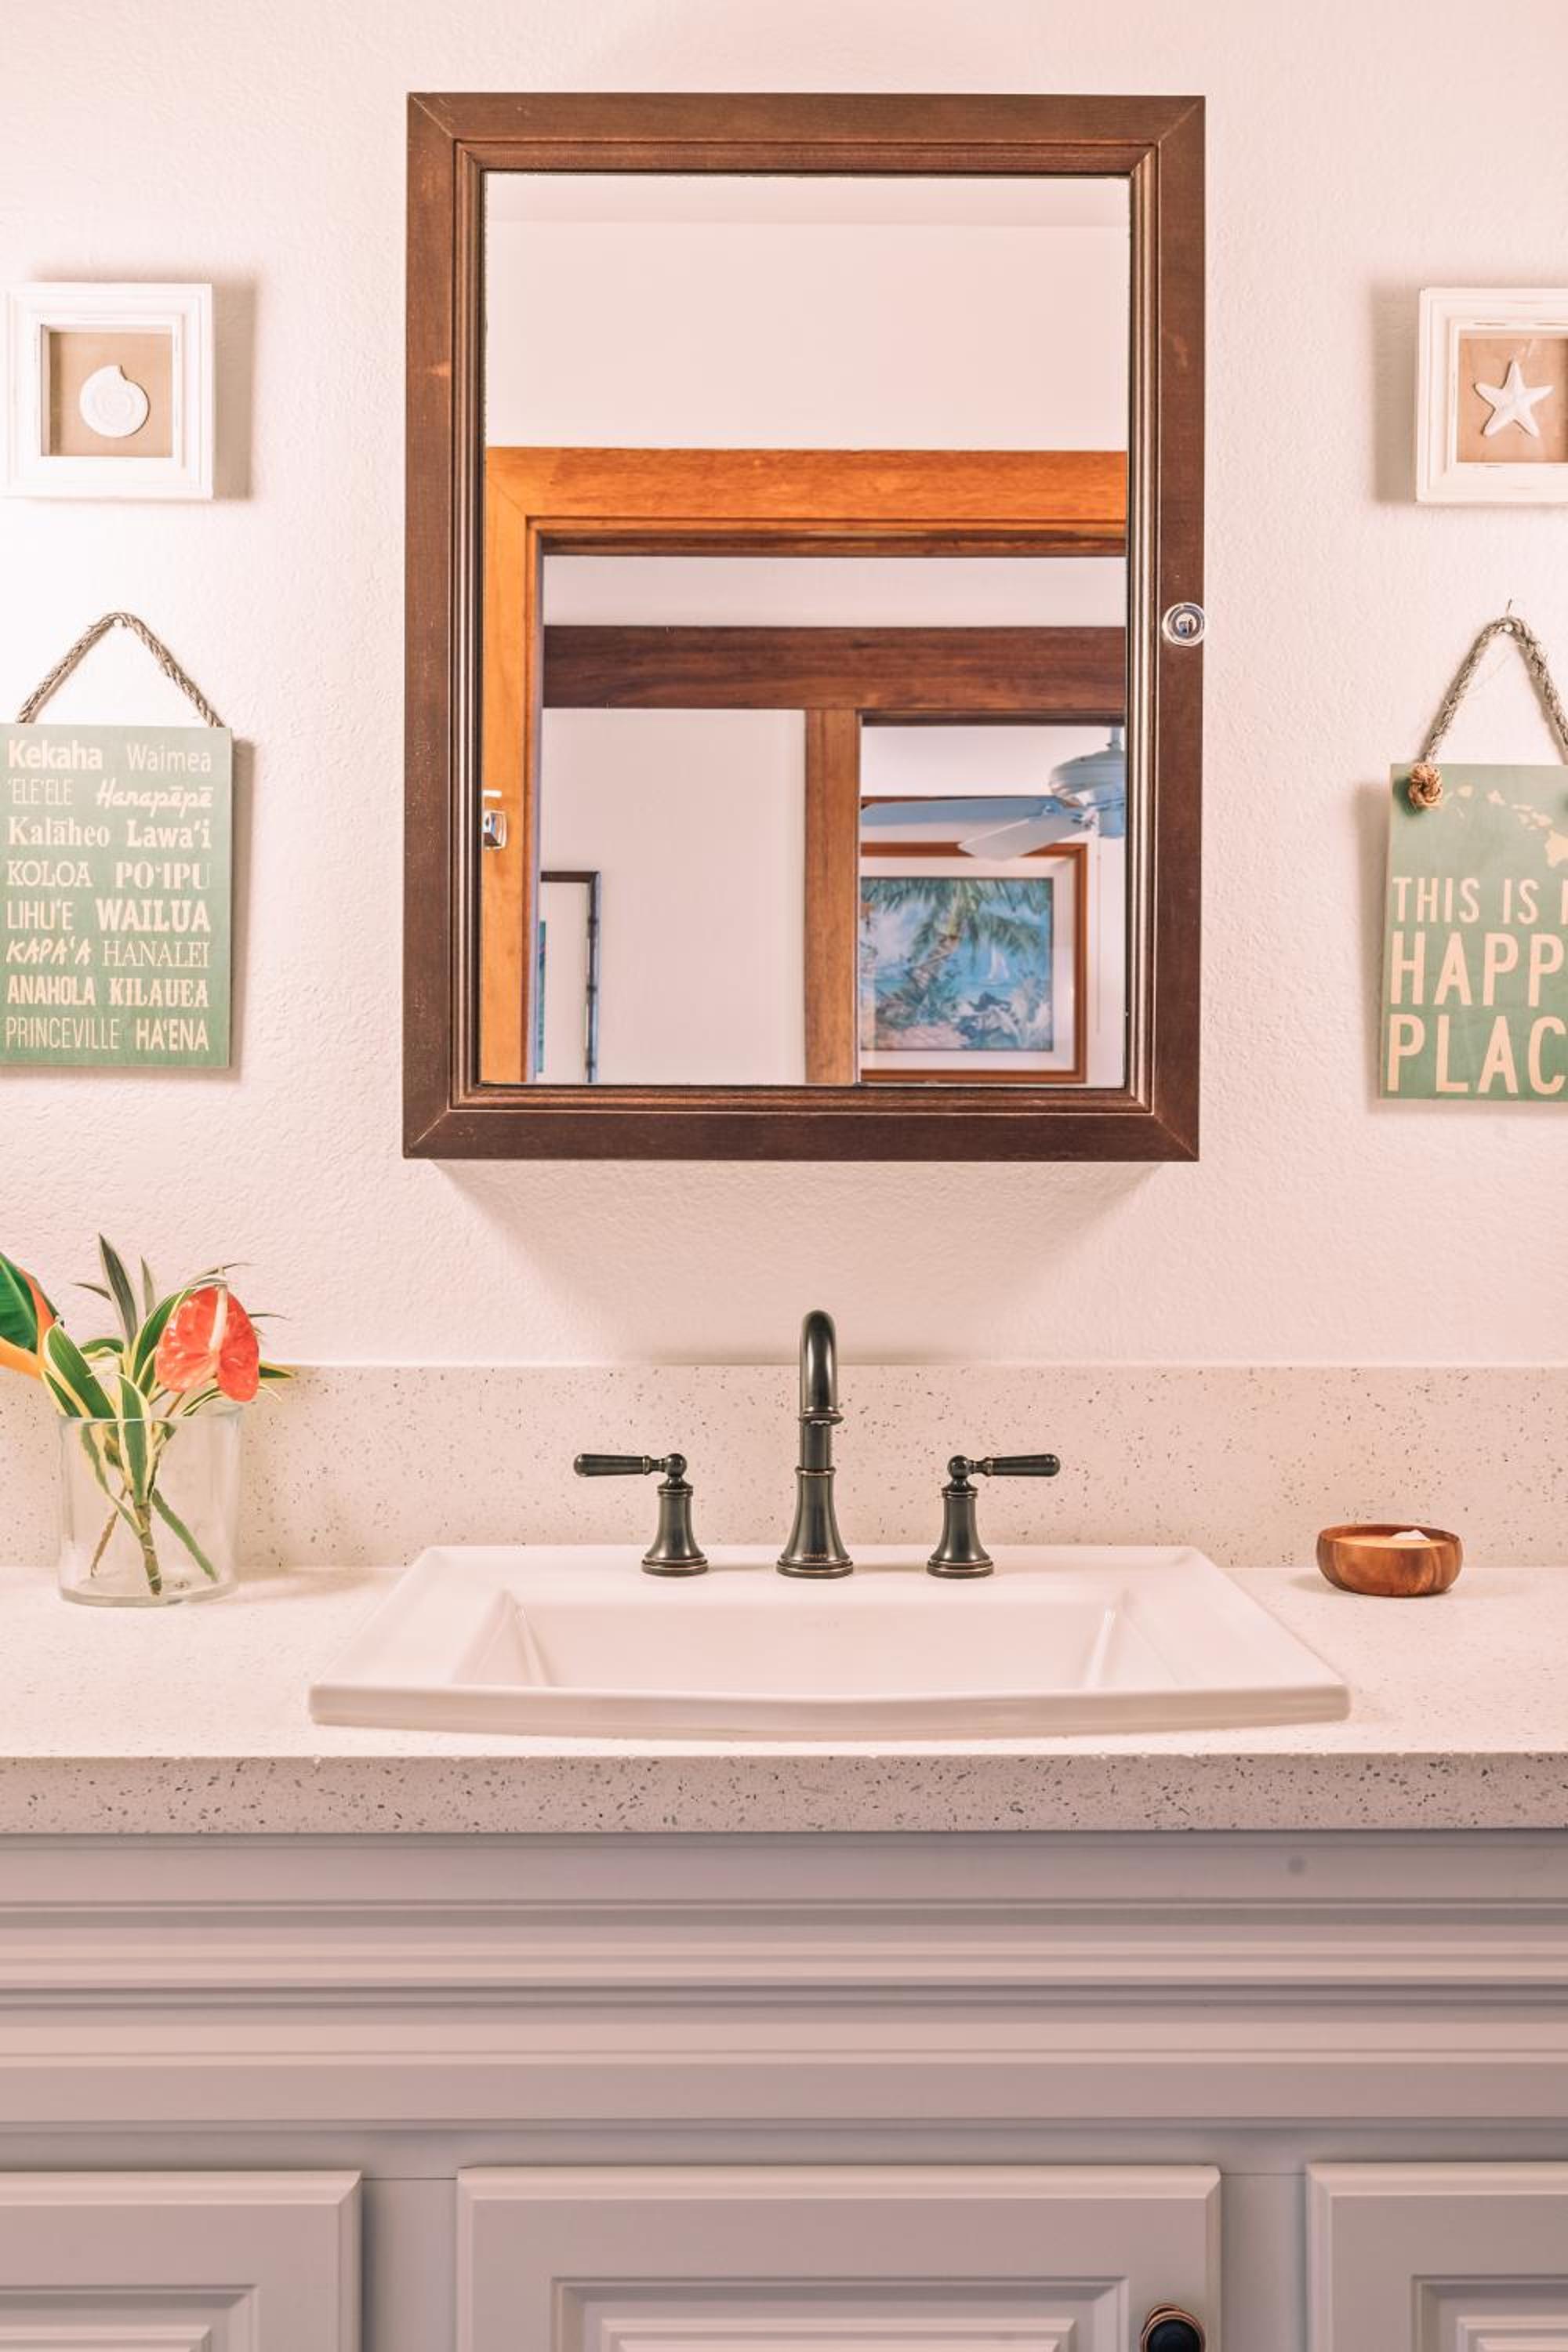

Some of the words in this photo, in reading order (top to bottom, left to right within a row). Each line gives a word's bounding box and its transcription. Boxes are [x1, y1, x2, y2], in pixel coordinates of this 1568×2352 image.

[8, 740, 103, 770] Kekaha
[126, 744, 212, 771] Waimea
[96, 778, 213, 818] Hanapēpē
[9, 816, 110, 847] Kalāheo
[126, 819, 212, 848] Lawa'i
[7, 860, 93, 887] KOLOA
[6, 899, 74, 931] LIHU'E
[95, 899, 211, 932] WAILUA
[1392, 877, 1480, 923] THIS
[1503, 878, 1539, 924] IS
[5, 936, 92, 965] KAPA'A
[102, 941, 210, 967] HANALEI
[1390, 931, 1565, 1007] HAPP
[7, 975, 96, 1005] ANAHOLA
[109, 978, 209, 1007] KILAUEA
[5, 1017, 120, 1050] PRINCEVILLE
[136, 1018, 209, 1051] HA'ENA
[1387, 1014, 1567, 1094] PLAC
